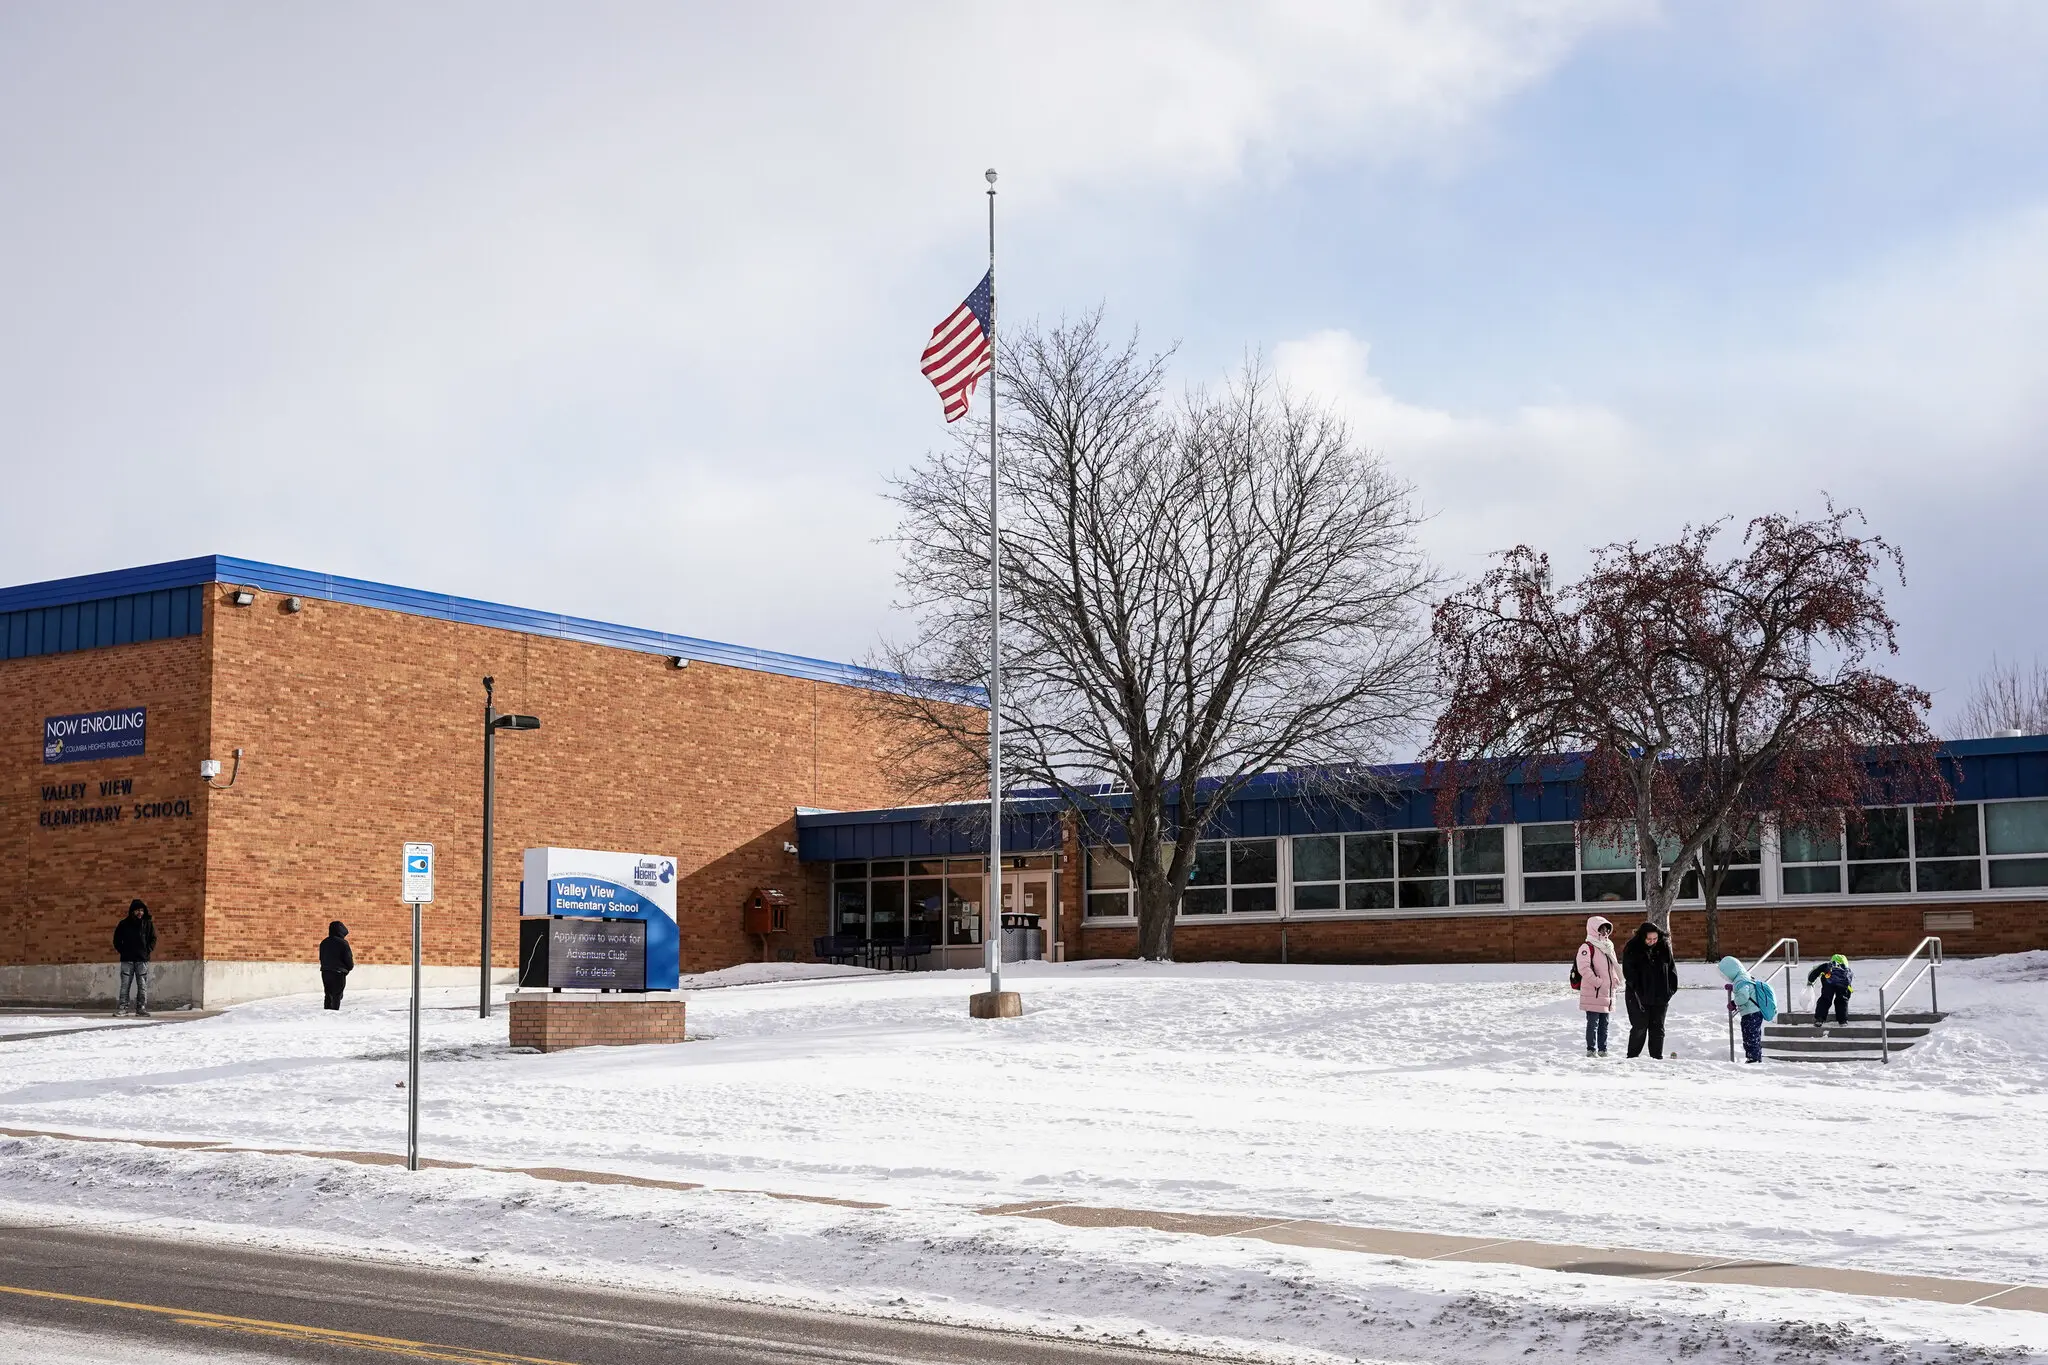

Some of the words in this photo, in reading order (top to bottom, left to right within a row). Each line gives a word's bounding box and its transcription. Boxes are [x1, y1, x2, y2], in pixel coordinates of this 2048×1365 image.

[47, 718, 78, 738] NOW
[80, 711, 144, 734] ENROLLING
[41, 782, 87, 802] VALLEY
[99, 778, 133, 797] VIEW
[40, 804, 123, 827] ELEMENTARY
[133, 799, 193, 820] SCHOOL
[634, 866, 657, 880] HEIGHTS
[556, 882, 587, 899] Valley
[590, 884, 615, 898] View
[556, 898, 606, 913] Elementary
[608, 901, 639, 913] School
[553, 931, 577, 943] Apply
[579, 933, 596, 942] now
[597, 933, 605, 943] to
[607, 934, 627, 943] work
[629, 933, 641, 944] for
[566, 948, 606, 960] Adventure
[575, 966, 589, 977] For
[590, 967, 616, 977] details
